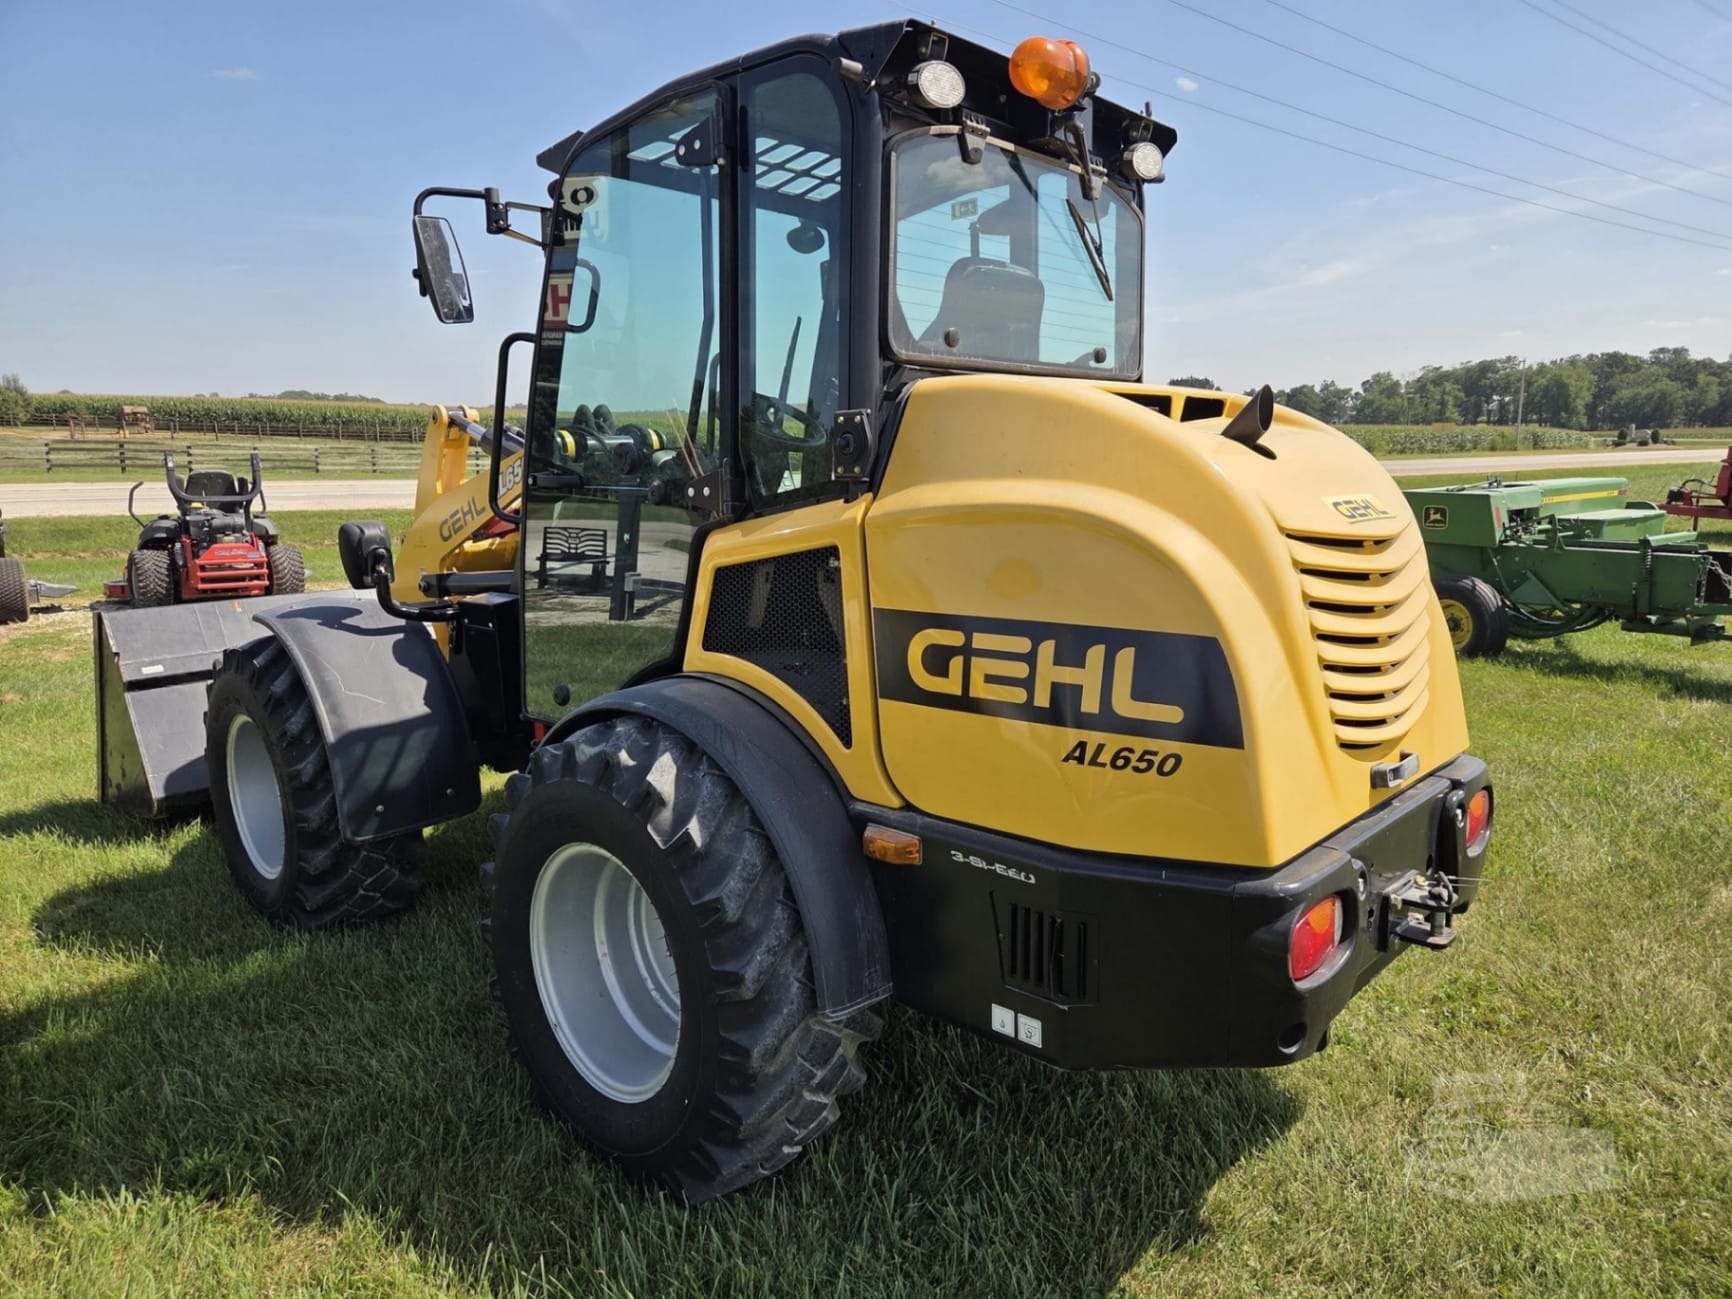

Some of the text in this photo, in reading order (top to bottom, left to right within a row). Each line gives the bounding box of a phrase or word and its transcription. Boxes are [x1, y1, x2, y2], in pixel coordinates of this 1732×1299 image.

[439, 496, 486, 542] GEHL
[1332, 499, 1390, 519] GEHL
[907, 628, 1184, 724] GEHL
[1061, 740, 1184, 778] AL650
